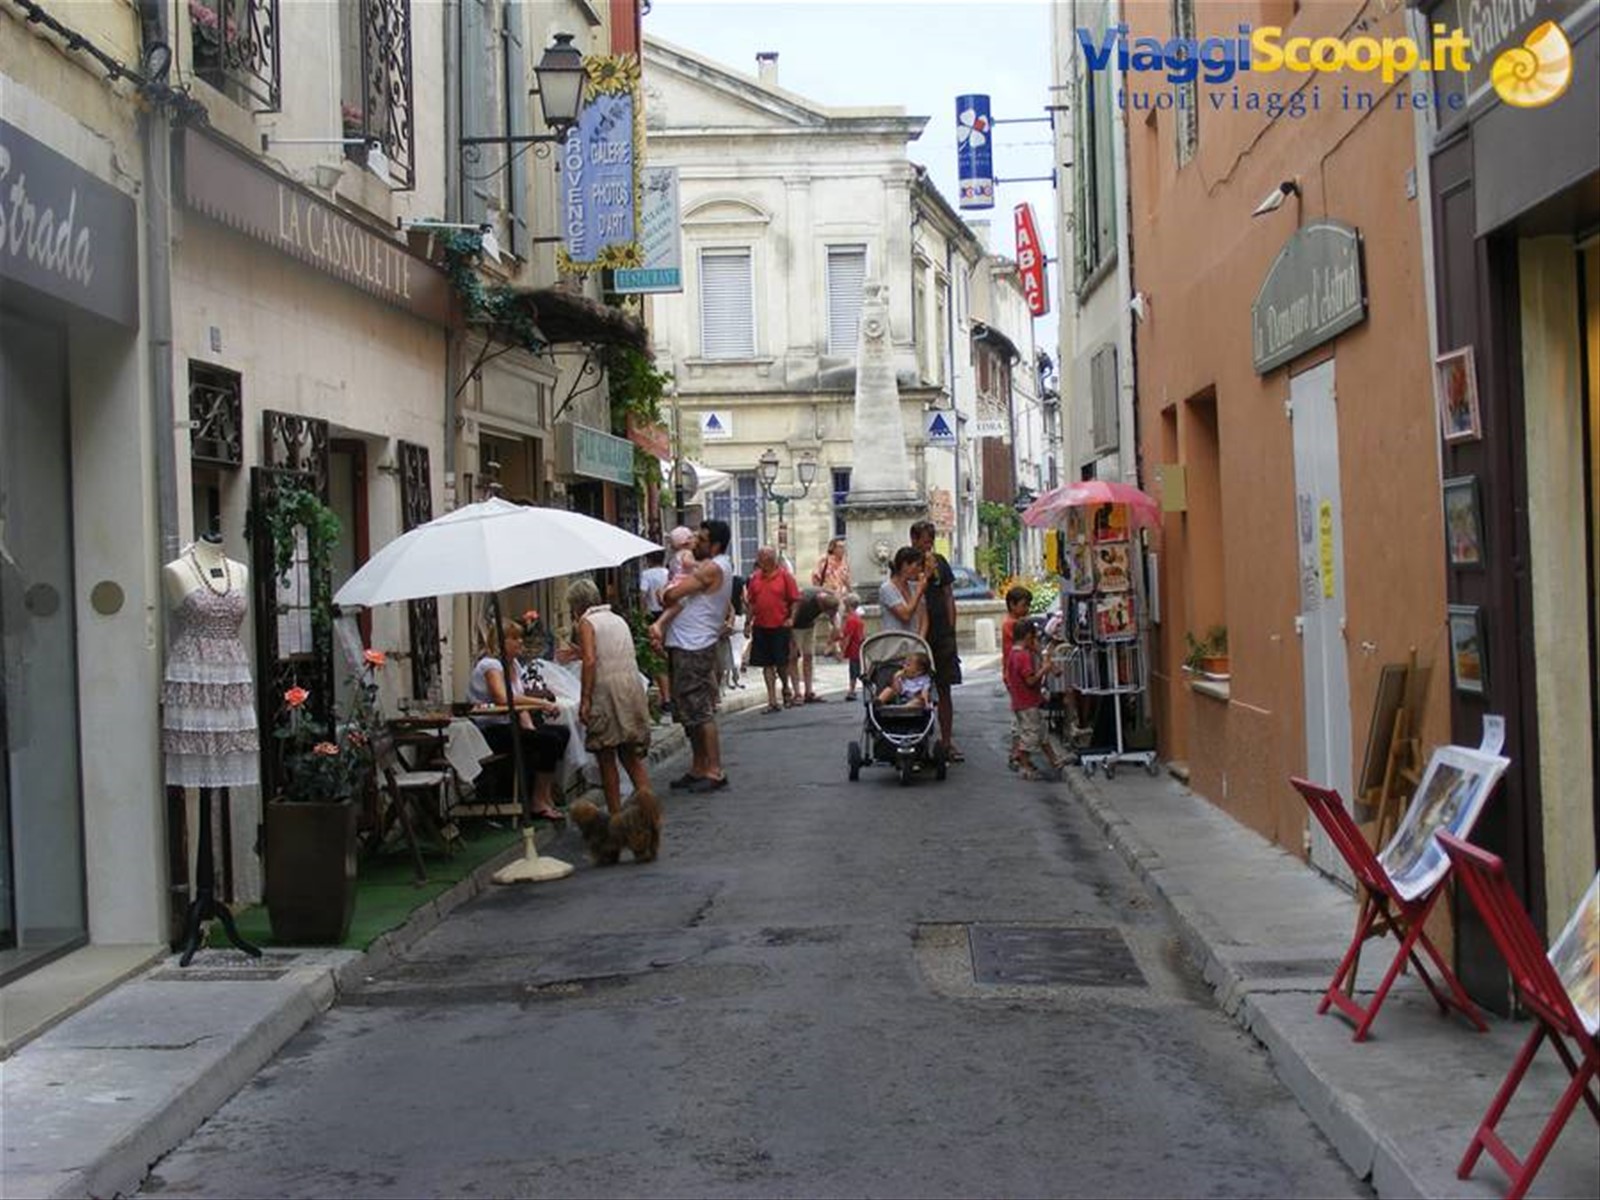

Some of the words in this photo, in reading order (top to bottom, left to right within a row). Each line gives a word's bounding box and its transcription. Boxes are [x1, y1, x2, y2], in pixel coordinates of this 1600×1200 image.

[591, 141, 631, 165] GALERIE
[592, 182, 631, 206] PHOTOS
[279, 185, 302, 248] LA
[307, 202, 411, 300] CASSOLETTE
[1014, 203, 1041, 311] TABAC
